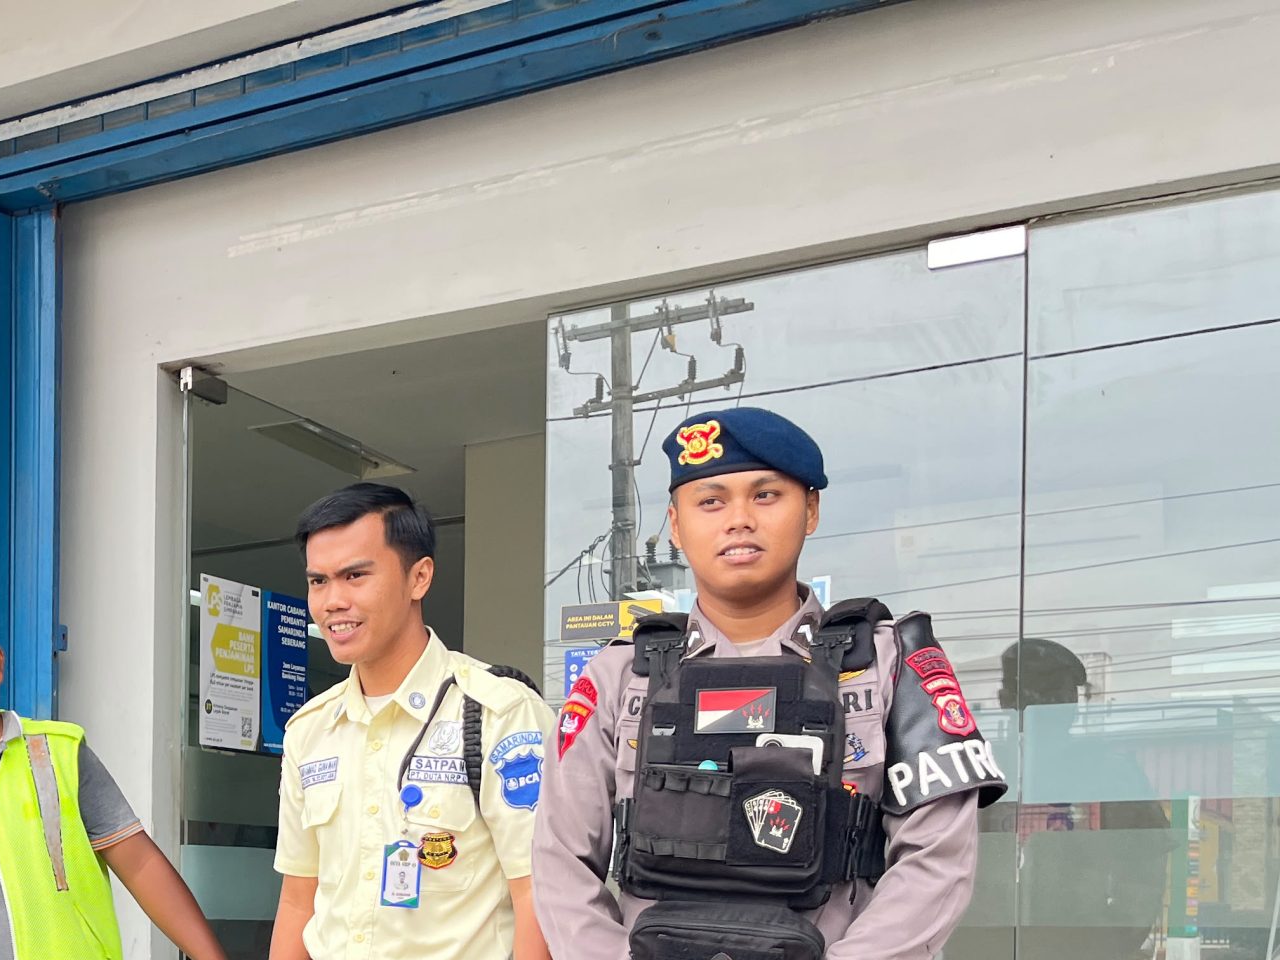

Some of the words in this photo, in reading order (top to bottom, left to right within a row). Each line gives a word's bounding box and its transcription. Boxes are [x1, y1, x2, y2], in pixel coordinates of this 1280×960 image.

[267, 601, 286, 612] KANTOR
[287, 606, 306, 617] CABANG
[281, 615, 305, 627] PEMBANTU
[566, 621, 597, 629] PANTAUAN
[239, 632, 254, 641] BANK
[278, 625, 306, 638] SAMARINDA
[230, 640, 254, 652] PESERTA
[282, 637, 305, 649] SEBERANG
[216, 648, 254, 662] PENJAMINAN
[571, 649, 586, 657] TATA
[244, 663, 254, 673] LPS
[842, 689, 873, 713] RI
[491, 733, 539, 761] SAMARINDA
[445, 774, 461, 782] NRP
[888, 739, 1005, 806] PATR
[519, 773, 539, 787] BCA
